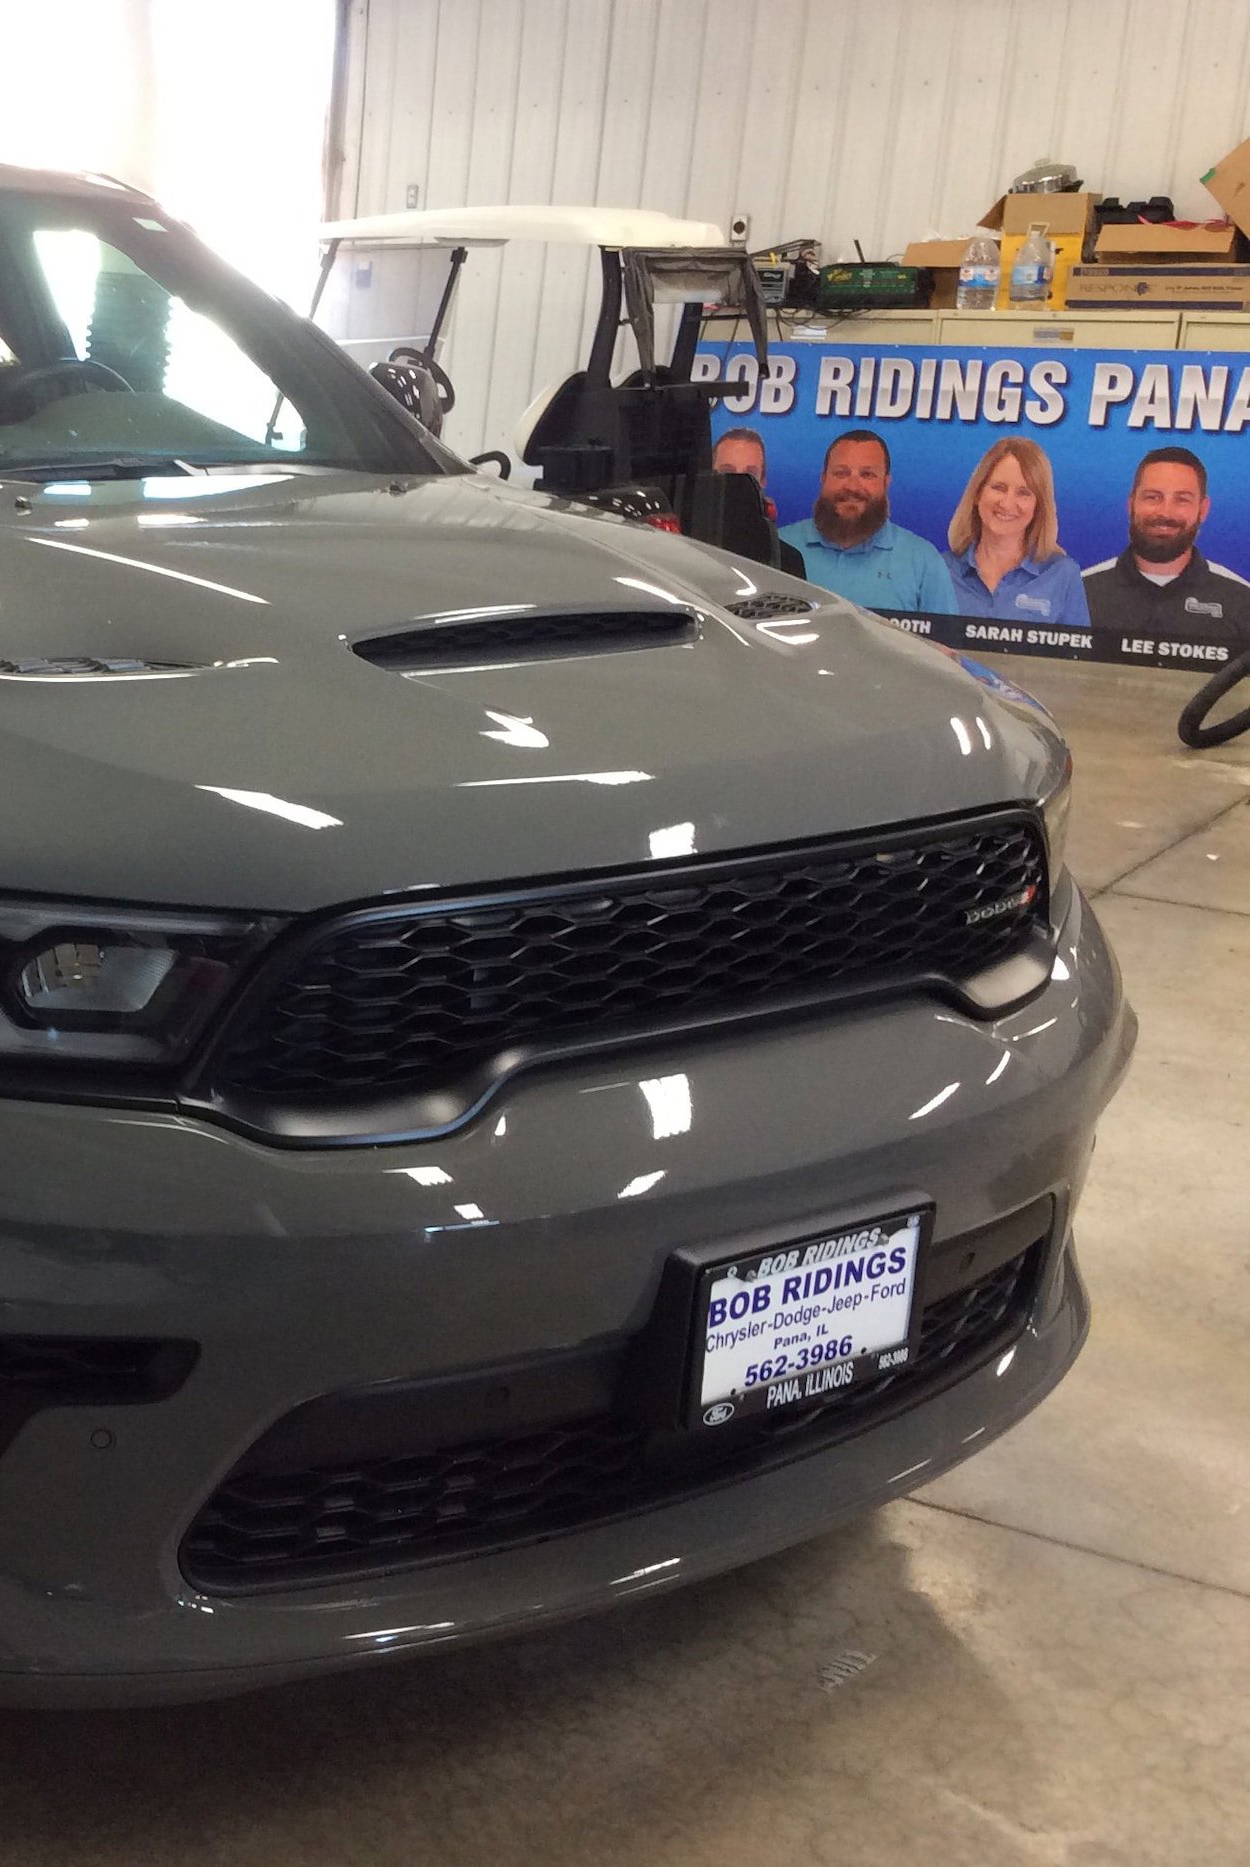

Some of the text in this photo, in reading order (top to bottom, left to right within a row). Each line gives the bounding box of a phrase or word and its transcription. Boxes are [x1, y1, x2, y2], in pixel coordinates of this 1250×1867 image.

[1079, 283, 1156, 296] RESPONE
[815, 356, 1068, 426] RIDINGS
[1088, 362, 1250, 432] PANA
[964, 624, 1093, 649] SARAH STUPEK
[1121, 638, 1229, 662] LEE STOKES
[757, 1227, 882, 1280] BOB RIDINGS
[708, 1247, 907, 1329] BOB RIDINGS
[706, 1278, 907, 1354] Chrysler-Dodge-Jeep-Ford
[773, 1324, 829, 1350] Pana, IL
[744, 1335, 854, 1388] 562-3986
[805, 1361, 855, 1397] ILLINOIS
